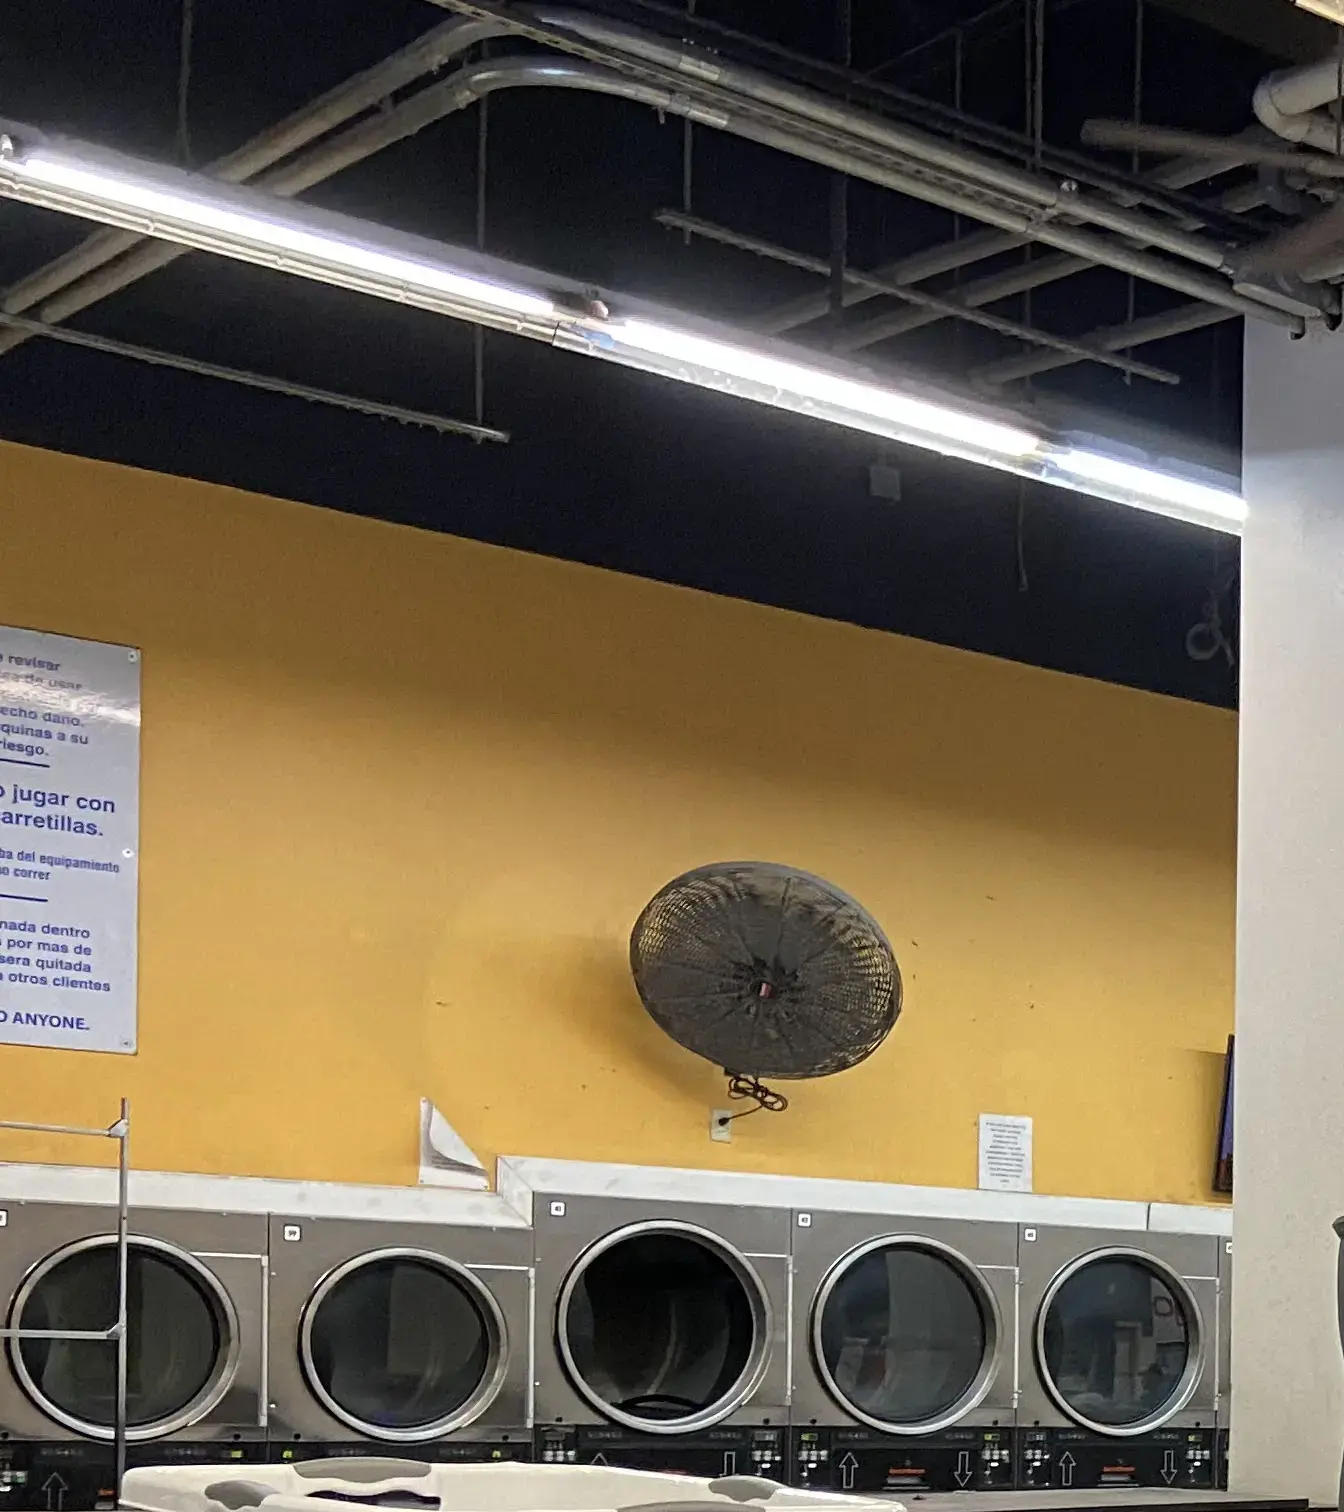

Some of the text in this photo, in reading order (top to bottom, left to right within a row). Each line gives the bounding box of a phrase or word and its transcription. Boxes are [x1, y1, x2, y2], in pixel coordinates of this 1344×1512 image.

[8, 654, 61, 671] revisar
[56, 731, 66, 742] a
[70, 734, 89, 745] su
[12, 784, 70, 808] jugar
[76, 796, 115, 813] con
[0, 811, 104, 837] arretillas.
[17, 850, 36, 862] del
[39, 854, 120, 874] equipamiento
[13, 867, 51, 880] correr
[41, 923, 91, 939] dentro
[7, 938, 92, 956] por mas de
[35, 958, 92, 974] quitada
[8, 972, 111, 992] otros clientes
[12, 1011, 90, 1031] ANYONE.
